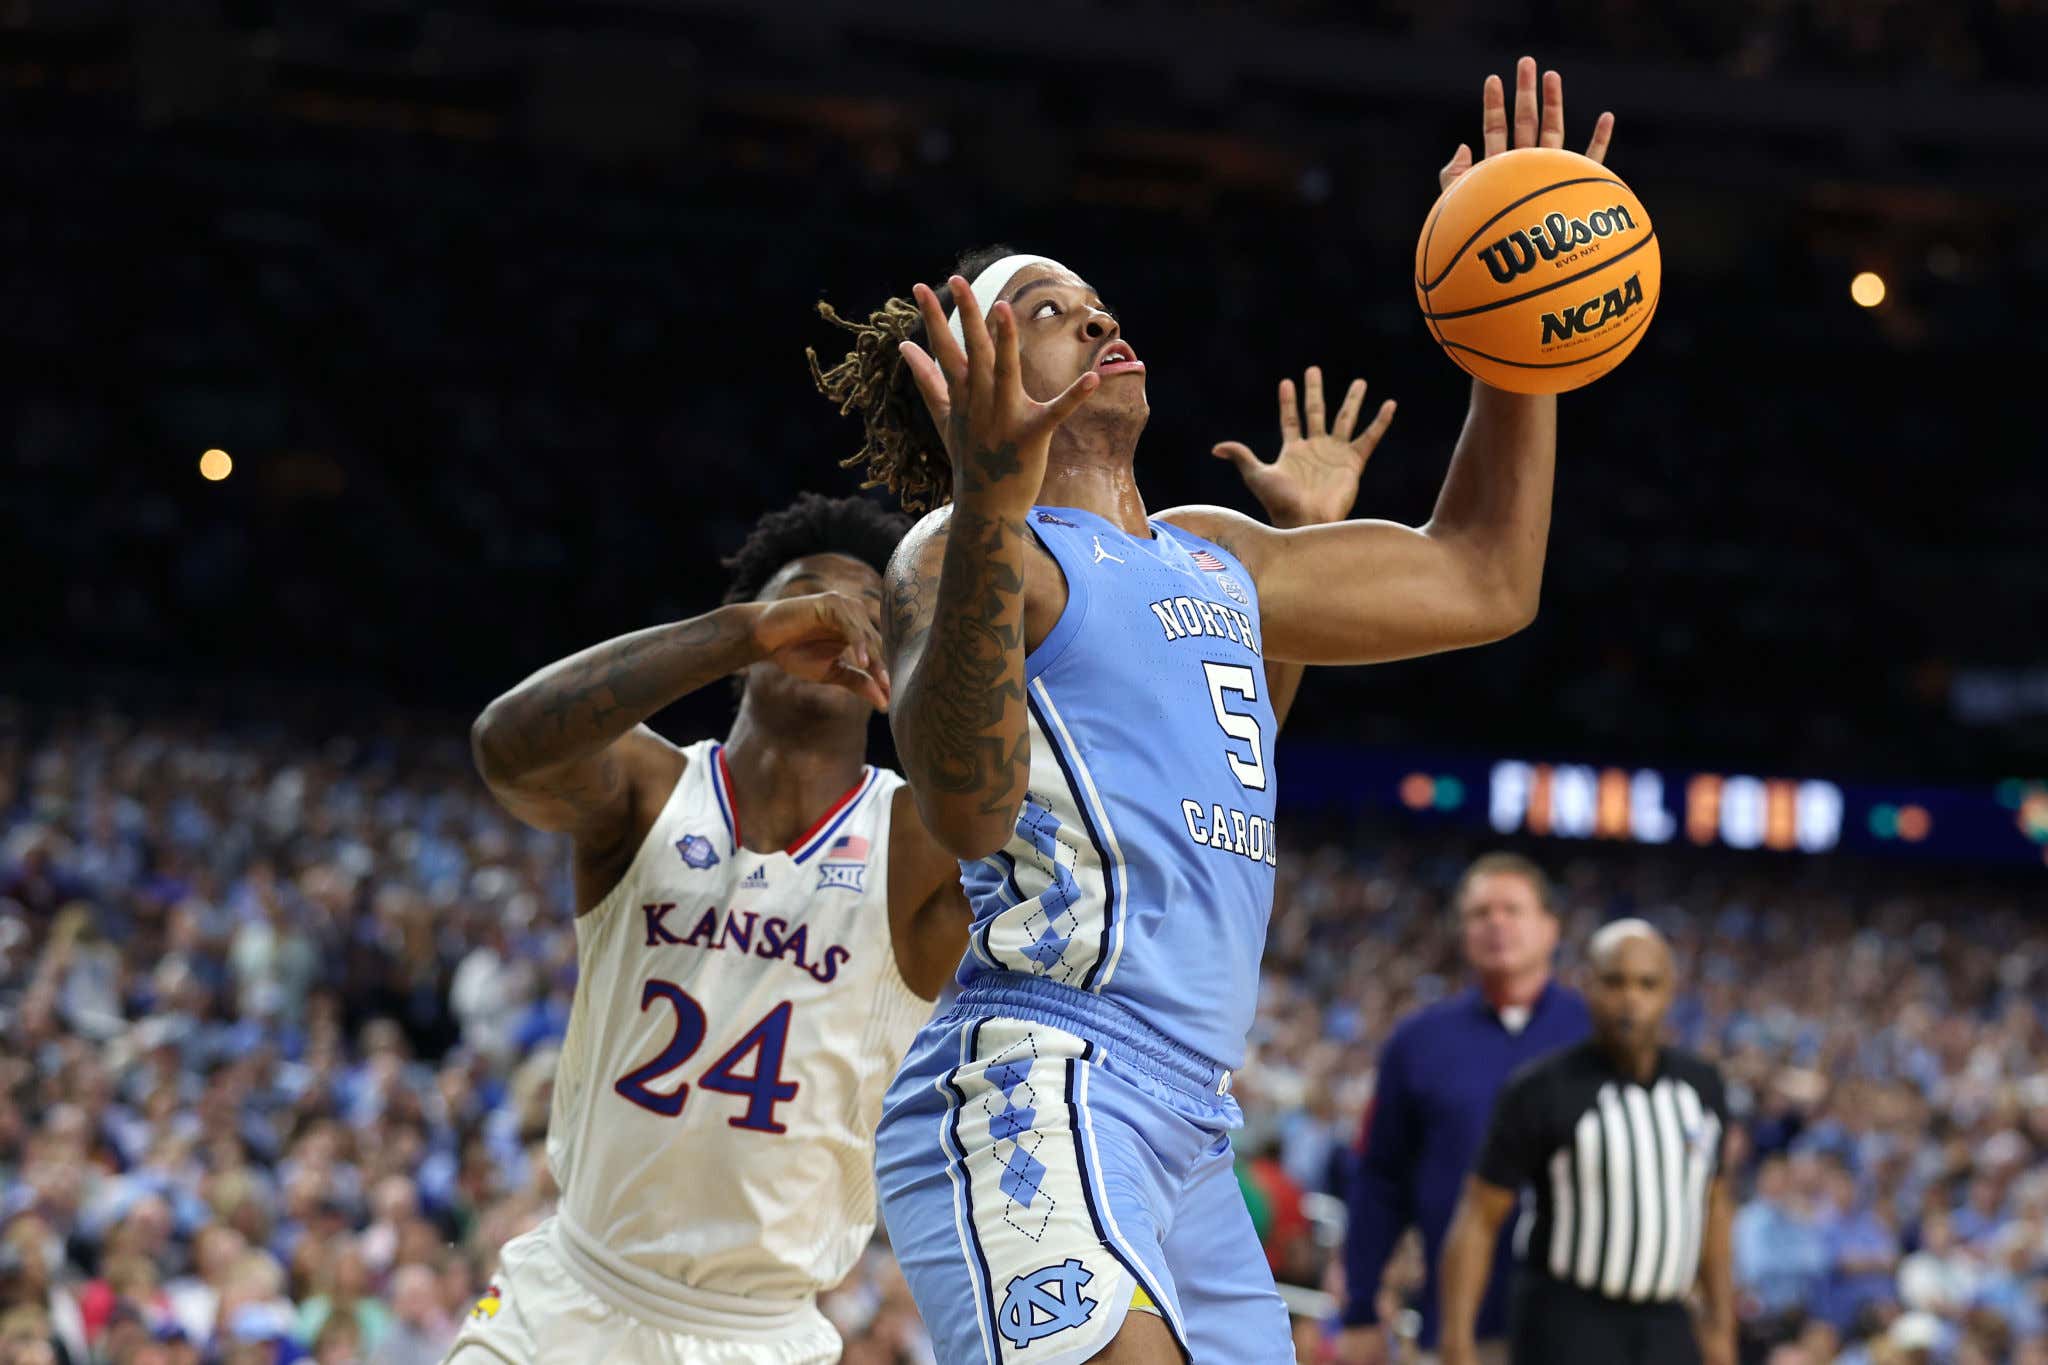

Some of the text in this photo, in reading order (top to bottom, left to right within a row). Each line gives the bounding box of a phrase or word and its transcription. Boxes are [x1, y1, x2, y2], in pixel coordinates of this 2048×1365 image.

[1478, 203, 1637, 284] Wilson
[1555, 243, 1601, 269] EVO NXT
[1540, 273, 1644, 345] NCAA
[1150, 595, 1260, 657] NORTH
[1201, 660, 1267, 792] 5
[642, 903, 850, 983] KANSAS
[614, 978, 800, 1135] 24
